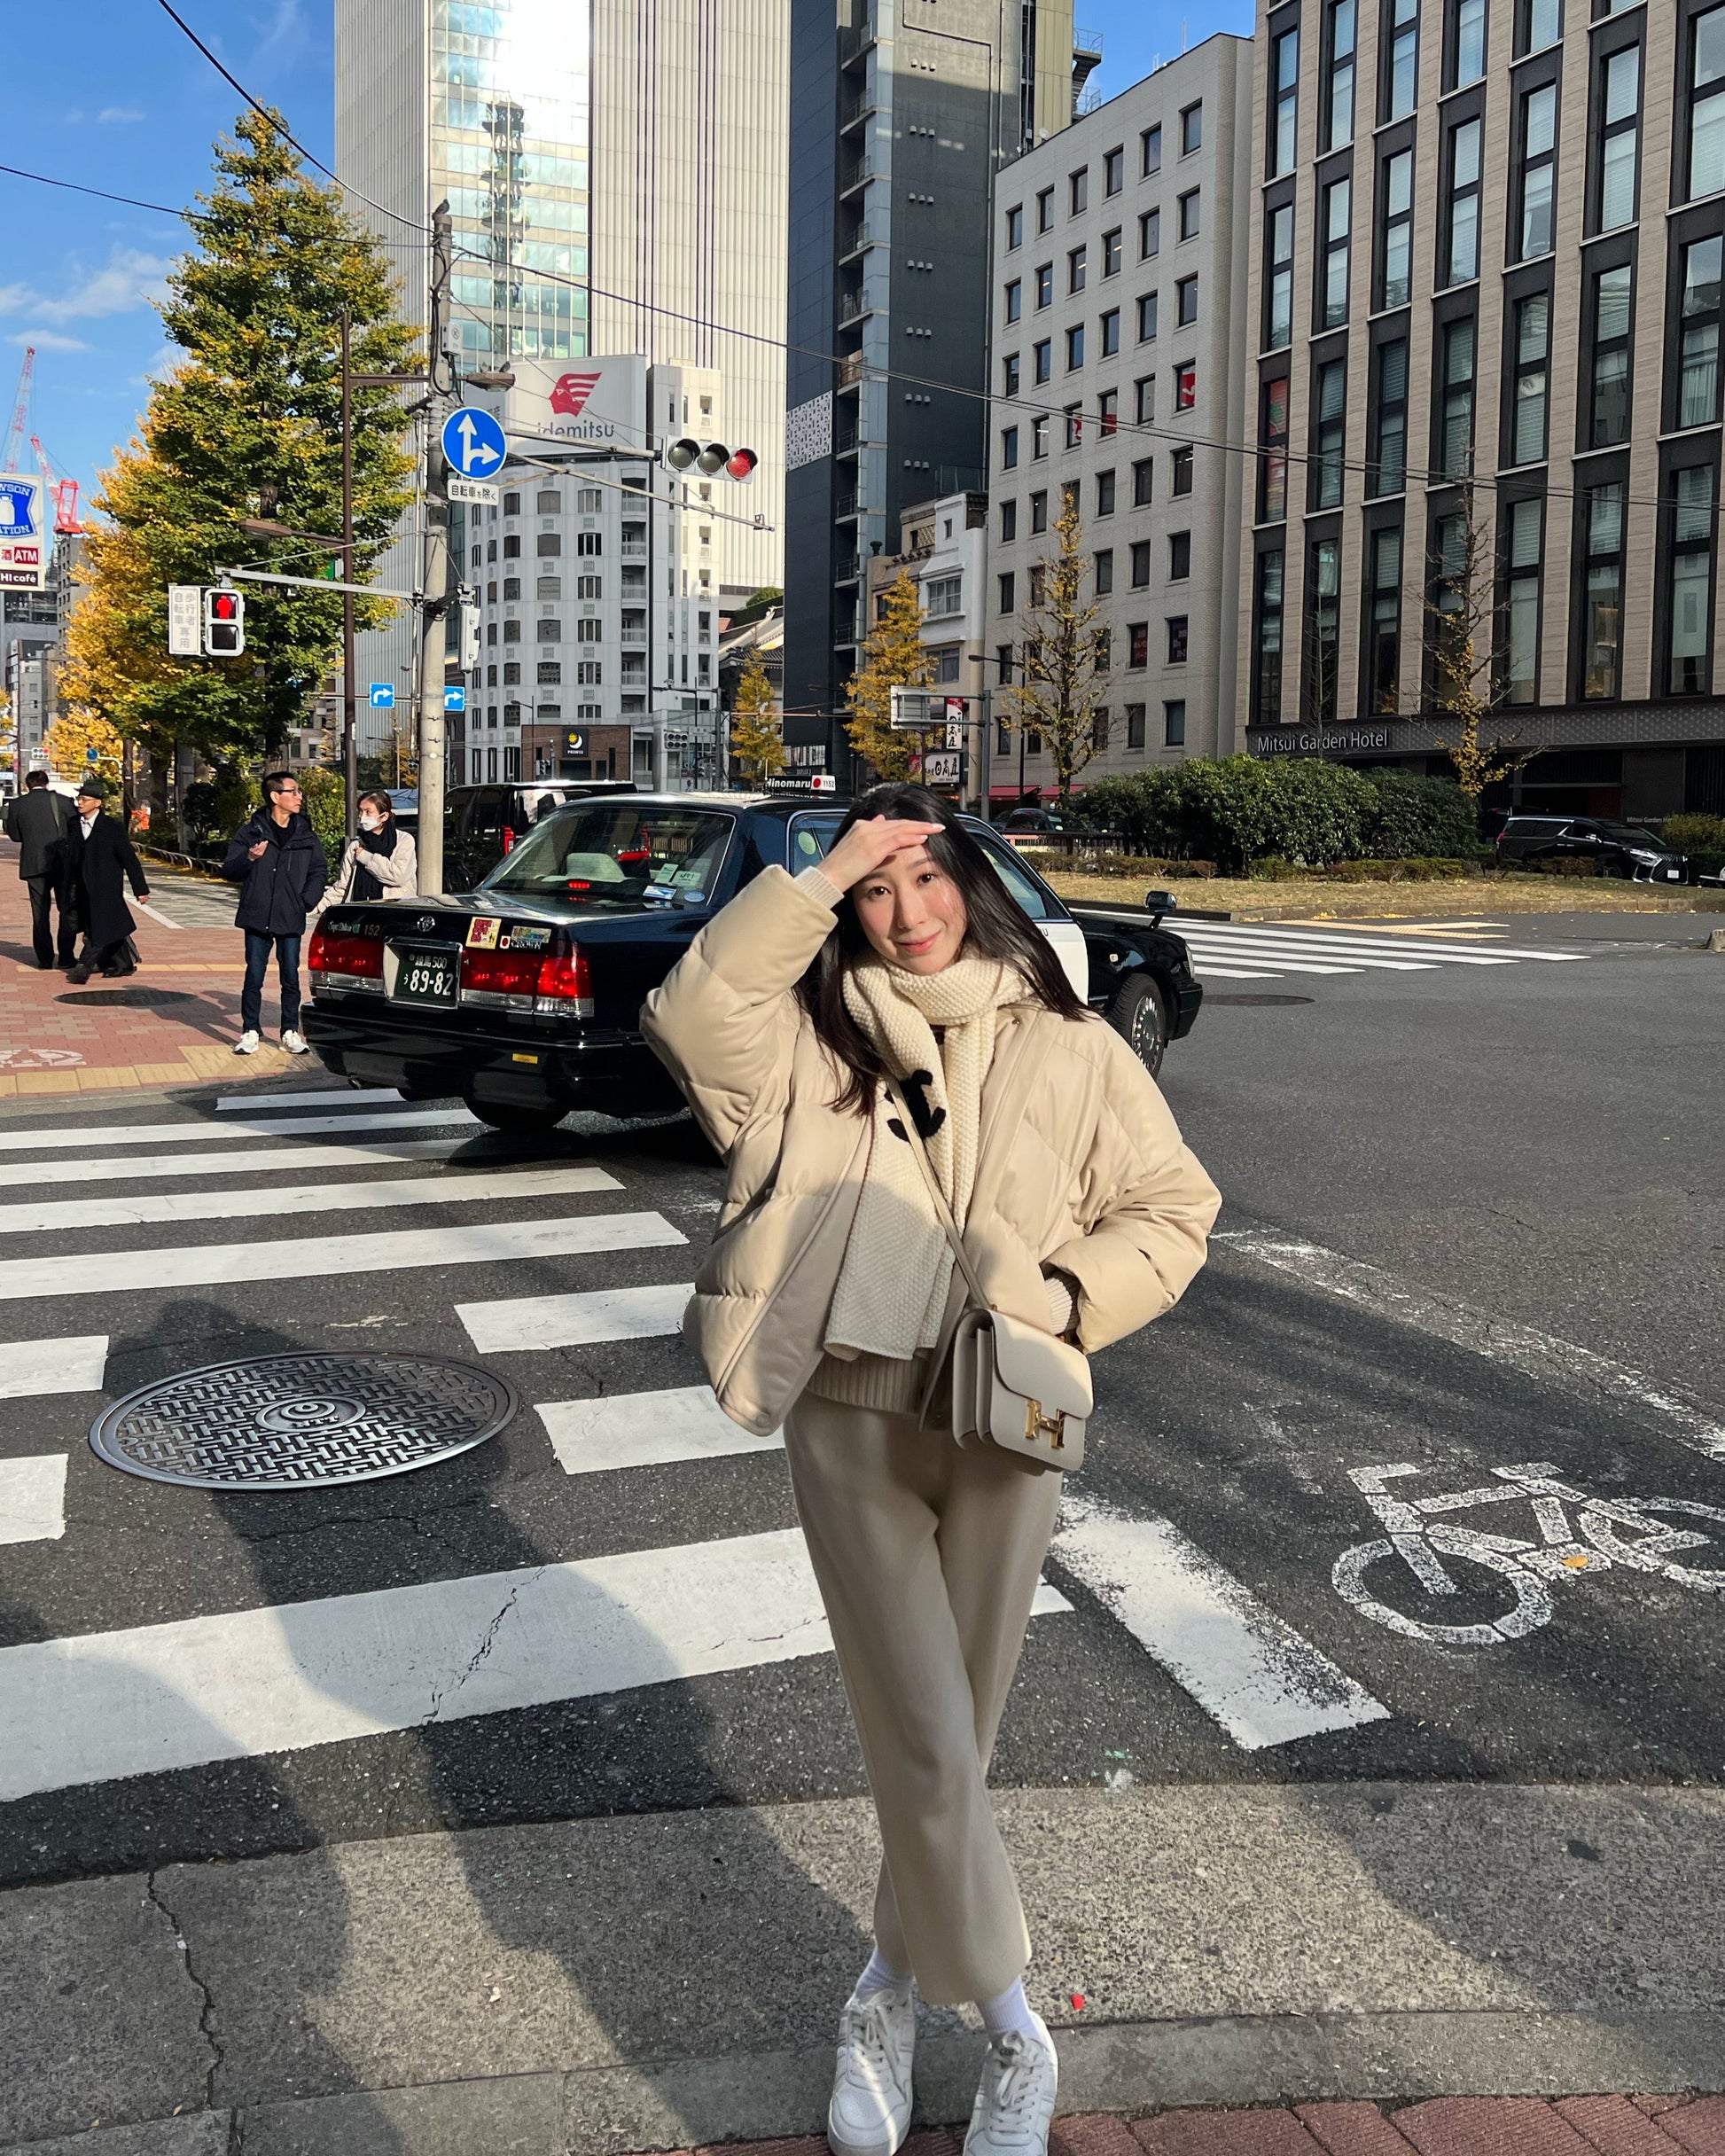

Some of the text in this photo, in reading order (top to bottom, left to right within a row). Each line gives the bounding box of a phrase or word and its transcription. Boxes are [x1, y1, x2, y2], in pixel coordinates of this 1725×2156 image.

[537, 419, 614, 439] idemitsu
[452, 485, 496, 500] 自転車を除く
[15, 551, 37, 562] ATM
[13, 573, 36, 583] café
[1258, 736, 1296, 752] Mitsui
[1351, 729, 1387, 747] Hotel
[823, 779, 835, 788] 1152
[364, 925, 380, 937] 152
[432, 957, 447, 969] 500
[410, 968, 454, 996] 89-82
